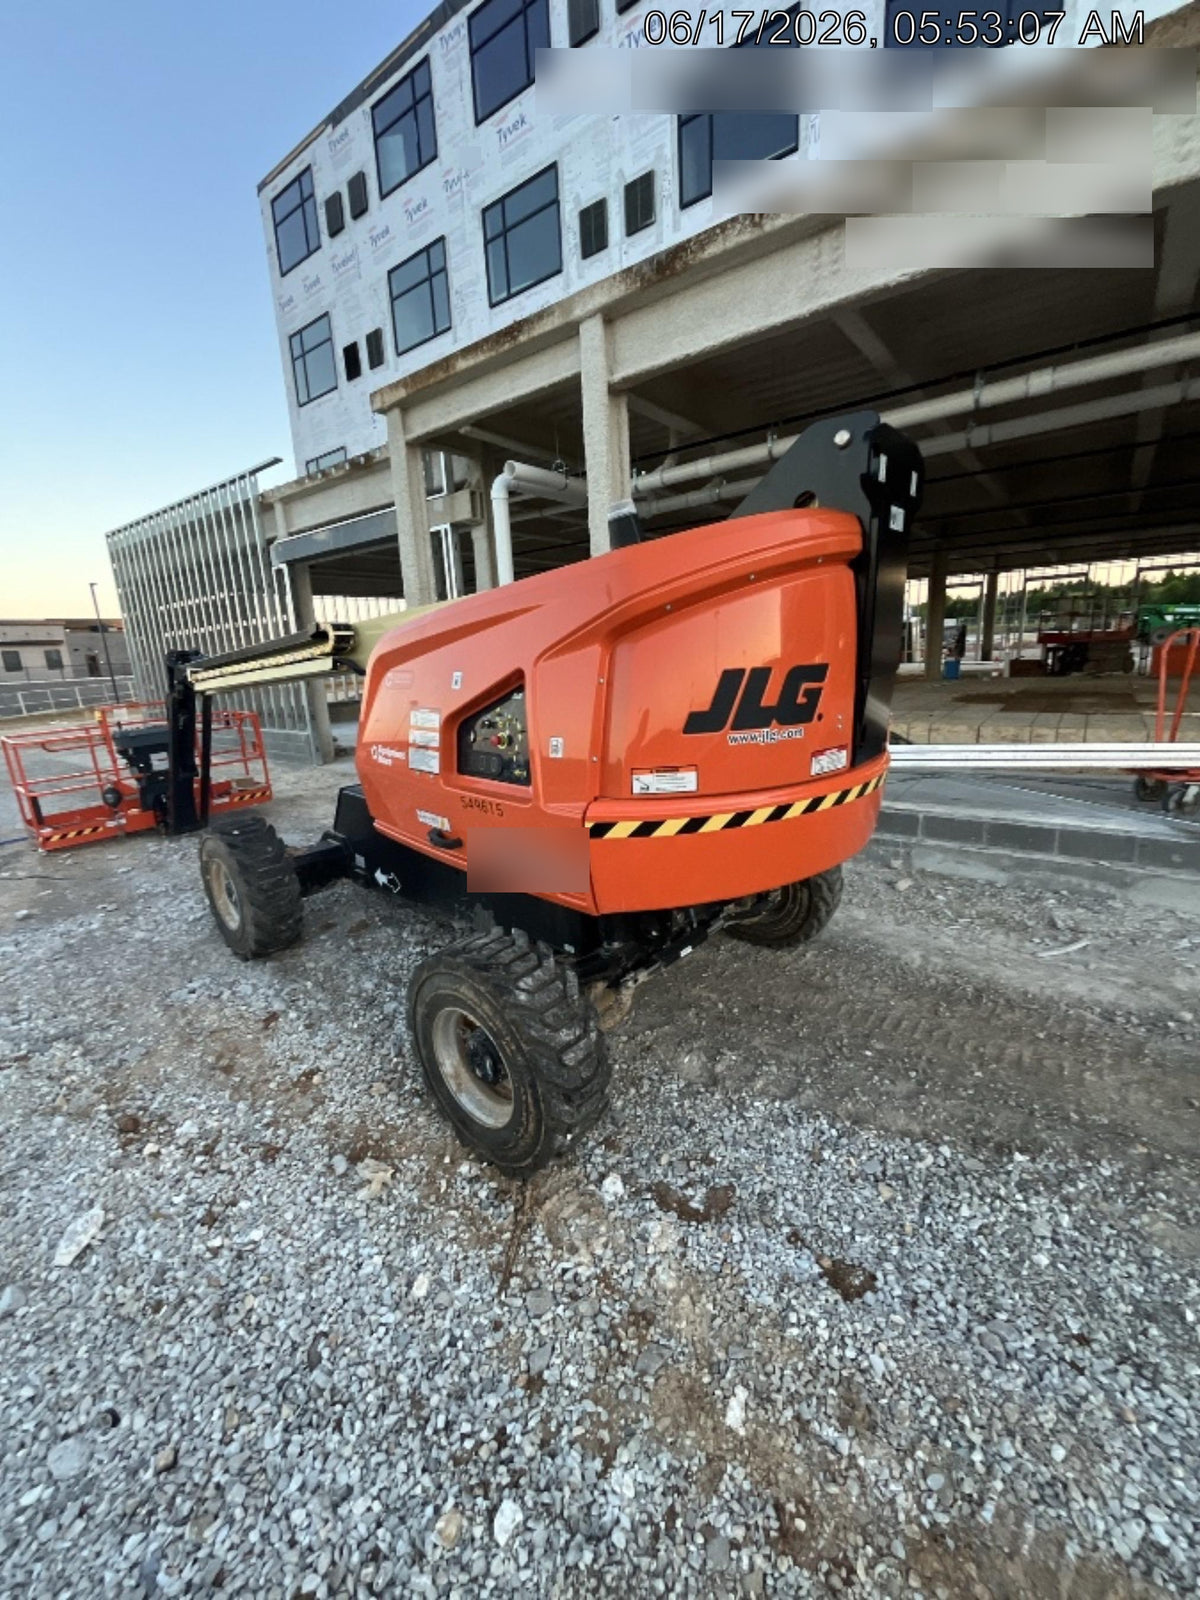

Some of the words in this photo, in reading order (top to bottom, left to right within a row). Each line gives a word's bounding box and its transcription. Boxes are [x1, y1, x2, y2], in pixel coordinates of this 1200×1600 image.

[496, 113, 527, 143] Tyvek
[682, 663, 830, 735] JLG
[728, 727, 805, 746] www.jlg.com
